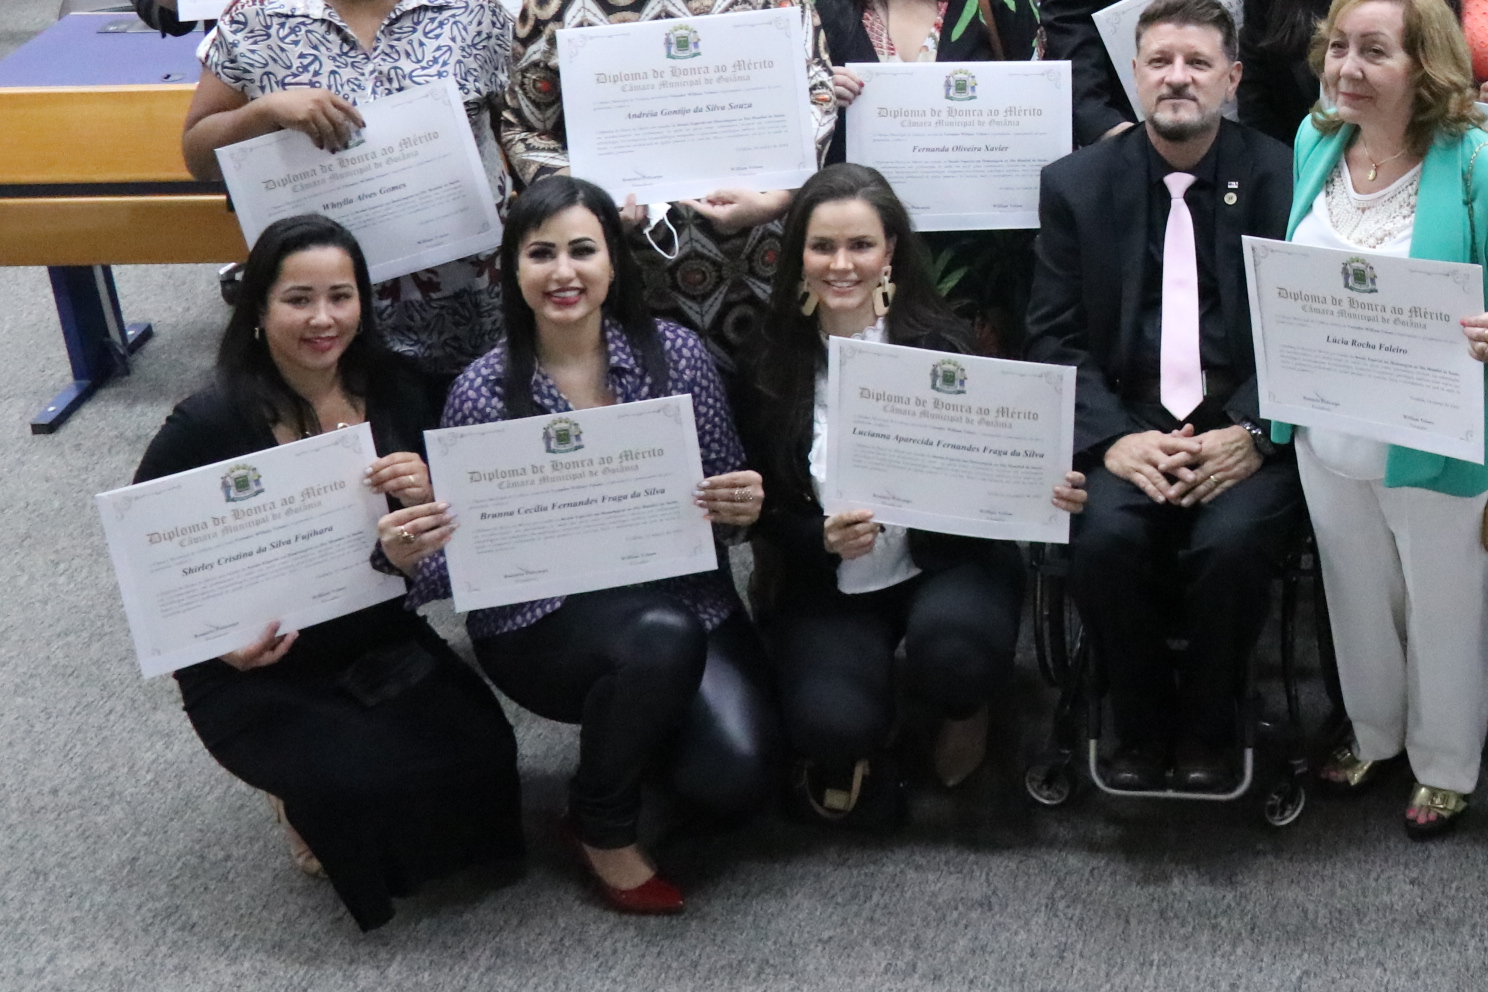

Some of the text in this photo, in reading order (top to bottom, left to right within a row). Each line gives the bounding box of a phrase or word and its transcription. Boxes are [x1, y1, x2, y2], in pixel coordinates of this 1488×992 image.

[594, 56, 775, 86] Diploma de Honra ao Mérito
[877, 105, 1042, 119] Diploma de Honra ao Mérito
[1276, 285, 1450, 324] Diploma de Honra ao Mérito
[858, 387, 1039, 422] Diploma de Honra ao Mérito
[467, 444, 664, 485] Diploma de Honra ao Mérito
[146, 476, 347, 547] Diploma de Honra ao Mérito
